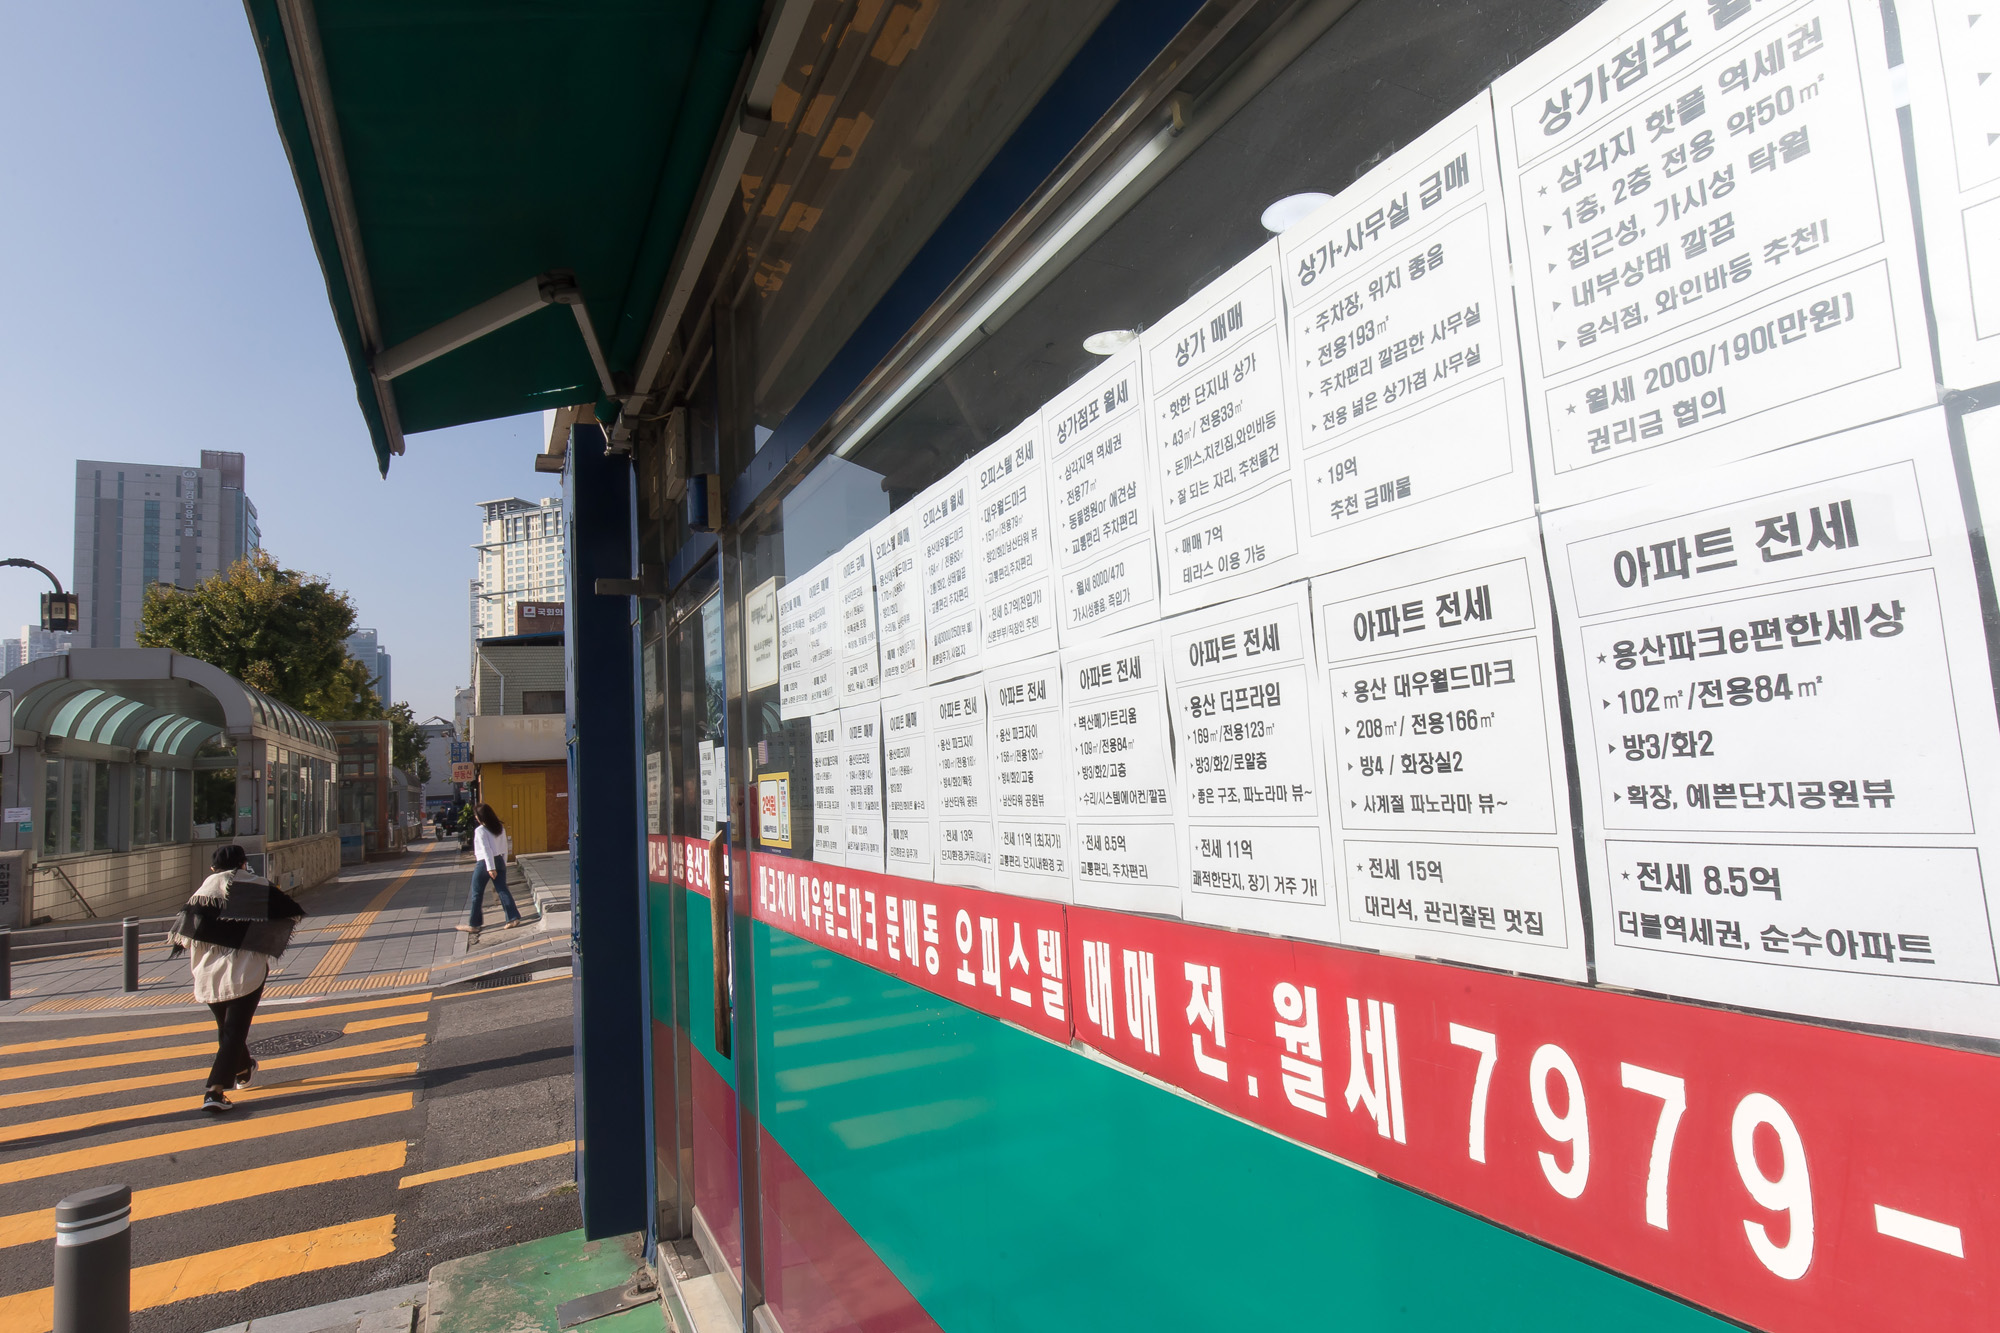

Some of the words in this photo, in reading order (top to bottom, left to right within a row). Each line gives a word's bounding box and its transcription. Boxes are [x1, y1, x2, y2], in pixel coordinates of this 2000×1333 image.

[1539, 10, 1692, 136] 상가점포
[1556, 126, 1636, 193] 삼각지
[1645, 85, 1706, 143] 핫플
[1718, 16, 1824, 95] 역세권
[1419, 152, 1470, 210] 급매
[1562, 195, 1605, 230] 1층,
[1613, 166, 1652, 204] 2층
[1661, 129, 1716, 178] 전용
[1566, 214, 1647, 270] 접근성,
[1655, 164, 1736, 227] 가시성
[1748, 125, 1811, 173] 탁월
[1571, 243, 1671, 307] 내부상태
[1680, 212, 1736, 260] 깔끔
[1315, 292, 1364, 332] 주차장,
[1368, 267, 1402, 302] 위치
[1408, 243, 1444, 281] 좋음
[1576, 304, 1649, 347] 음식점,
[1655, 253, 1753, 316] 와인바등
[1763, 219, 1829, 266] 추천!
[1175, 327, 1205, 367] 상가
[1211, 301, 1243, 343] 매매
[1320, 356, 1373, 397] 주차편리
[1378, 331, 1425, 369] 깔끔한
[1431, 302, 1481, 344] 사무실
[1170, 392, 1190, 420] 핫한
[1195, 370, 1229, 405] 단지내
[1233, 352, 1256, 382] 상가
[1322, 406, 1347, 431] 전용
[1352, 392, 1378, 418] 넓은
[1383, 369, 1427, 404] 상가겸
[1433, 343, 1481, 382] 사무실
[1585, 376, 1636, 414] 월세
[1057, 399, 1100, 444] 상가점포
[1104, 379, 1128, 413] 월세
[1588, 409, 1664, 454] 권리금
[1673, 387, 1727, 430] 협의
[981, 454, 1012, 490] 오피스텔
[1016, 440, 1033, 468] 전세
[1065, 450, 1094, 481] 삼각지역
[1097, 433, 1121, 458] 역세권
[1177, 488, 1186, 505] 잘
[1189, 480, 1209, 499] 되는
[1213, 467, 1236, 489] 자리,
[1239, 443, 1279, 477] 추천물건
[1328, 456, 1358, 484] 19억
[923, 499, 948, 529] 오피스텔
[950, 488, 964, 512] 월세
[984, 485, 1027, 523] 대우월드마크
[1109, 481, 1136, 507] 애견샵
[1330, 494, 1359, 520] 추천
[1364, 475, 1411, 509] 급매물
[1072, 527, 1100, 554] 교통편리
[1103, 509, 1137, 538] 주차편리
[1182, 533, 1201, 553] 매매
[1205, 525, 1223, 545] 7억
[1613, 527, 1738, 589] 아파트
[1754, 499, 1859, 562] 전세
[1183, 560, 1213, 583] 테라스
[1218, 552, 1240, 572] 이용
[1245, 544, 1265, 564] 가능
[1077, 577, 1091, 596] 월세
[1353, 598, 1426, 642] 아파트
[1435, 584, 1492, 629] 전세
[1189, 634, 1237, 666] 아파트
[1244, 623, 1280, 656] 전세
[1612, 599, 1905, 670] 용산파크e편한세상
[1000, 684, 1024, 706] 아파트
[1028, 680, 1046, 702] 전세
[1080, 663, 1112, 690] 아파트
[1117, 656, 1141, 682] 전세
[1354, 677, 1387, 703] 용산
[1394, 659, 1516, 698] 대우월드마크
[940, 700, 961, 719] 아파트
[964, 696, 977, 715] 전세
[1079, 707, 1136, 731] 벽산메가트리움
[1190, 693, 1216, 718] 용산
[1220, 682, 1281, 712] 더프라임
[1000, 728, 1010, 742] 용산
[1012, 724, 1037, 740] 파크자이
[1622, 731, 1714, 762] 방3/화2
[1360, 755, 1384, 776] 방4
[1400, 751, 1463, 775] 화장실2
[1198, 788, 1214, 804] 좋은
[1218, 787, 1240, 803] 구조,
[1243, 785, 1288, 803] 파노라마
[1363, 794, 1405, 813] 사계절
[1411, 793, 1473, 814] 파노라마
[1626, 784, 1678, 810] 확장,
[1686, 779, 1895, 809] 예쁜단지공원뷰
[1004, 832, 1015, 846] 전세
[1017, 832, 1032, 847] 11억
[1086, 835, 1102, 851] 전세
[1105, 835, 1126, 852] 8.5억
[1201, 839, 1222, 858] 전세
[1227, 839, 1253, 860] 11억
[1113, 863, 1148, 879] 주차편리
[1193, 870, 1244, 890] 쾌적한단지,
[1248, 874, 1270, 892] 장기
[1274, 876, 1297, 895] 거주
[1368, 857, 1400, 880] 전세
[1407, 860, 1444, 883] 15억
[1636, 862, 1691, 895] 전세
[1704, 865, 1783, 901] 8.5억
[1365, 895, 1418, 922] 대리석,
[1424, 900, 1496, 930] 관리잘된
[1503, 907, 1544, 936] 멋집
[1618, 911, 1750, 950] 더블역세권,
[1759, 923, 1935, 964] 순수아파트
[800, 876, 878, 952] 대우월드마크
[887, 896, 940, 976] 문배동
[955, 908, 1066, 1022] 오피스텔
[1083, 940, 1160, 1059] 매매
